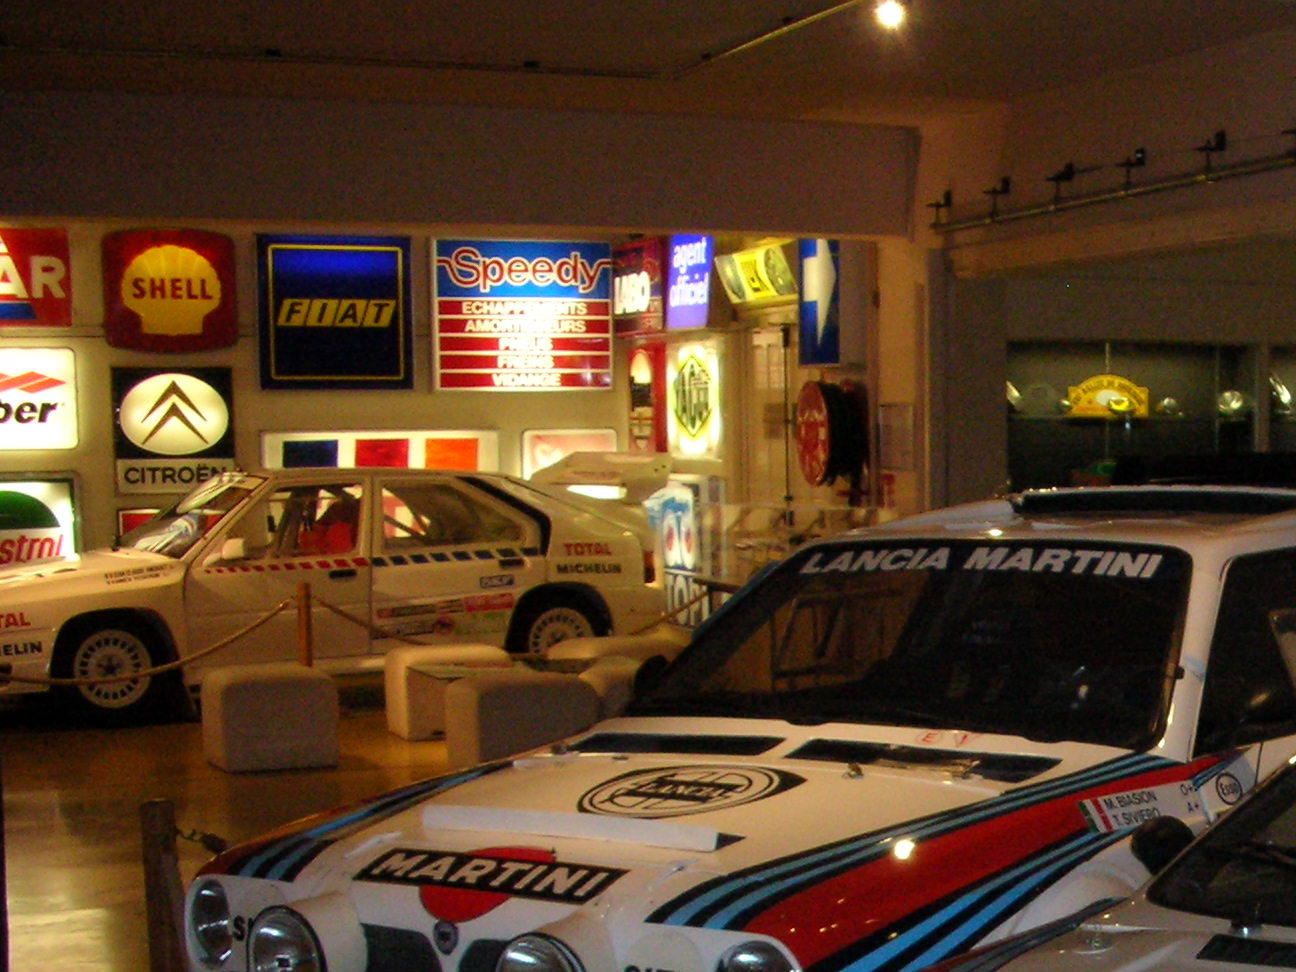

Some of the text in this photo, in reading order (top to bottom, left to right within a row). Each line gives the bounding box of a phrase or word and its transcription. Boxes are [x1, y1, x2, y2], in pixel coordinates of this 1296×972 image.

[673, 237, 707, 273] agent
[450, 247, 600, 293] Speedy
[132, 277, 214, 301] SHELL
[669, 272, 709, 307] officiel
[281, 300, 394, 325] FIAT
[462, 302, 588, 316] ECHAPPNTS
[464, 319, 587, 333] AMORTURS
[563, 542, 612, 556] TOTAL
[556, 562, 622, 575] MICHELIN
[802, 545, 1163, 579] LANCIA MARTINI
[370, 852, 610, 897] MARTINI
